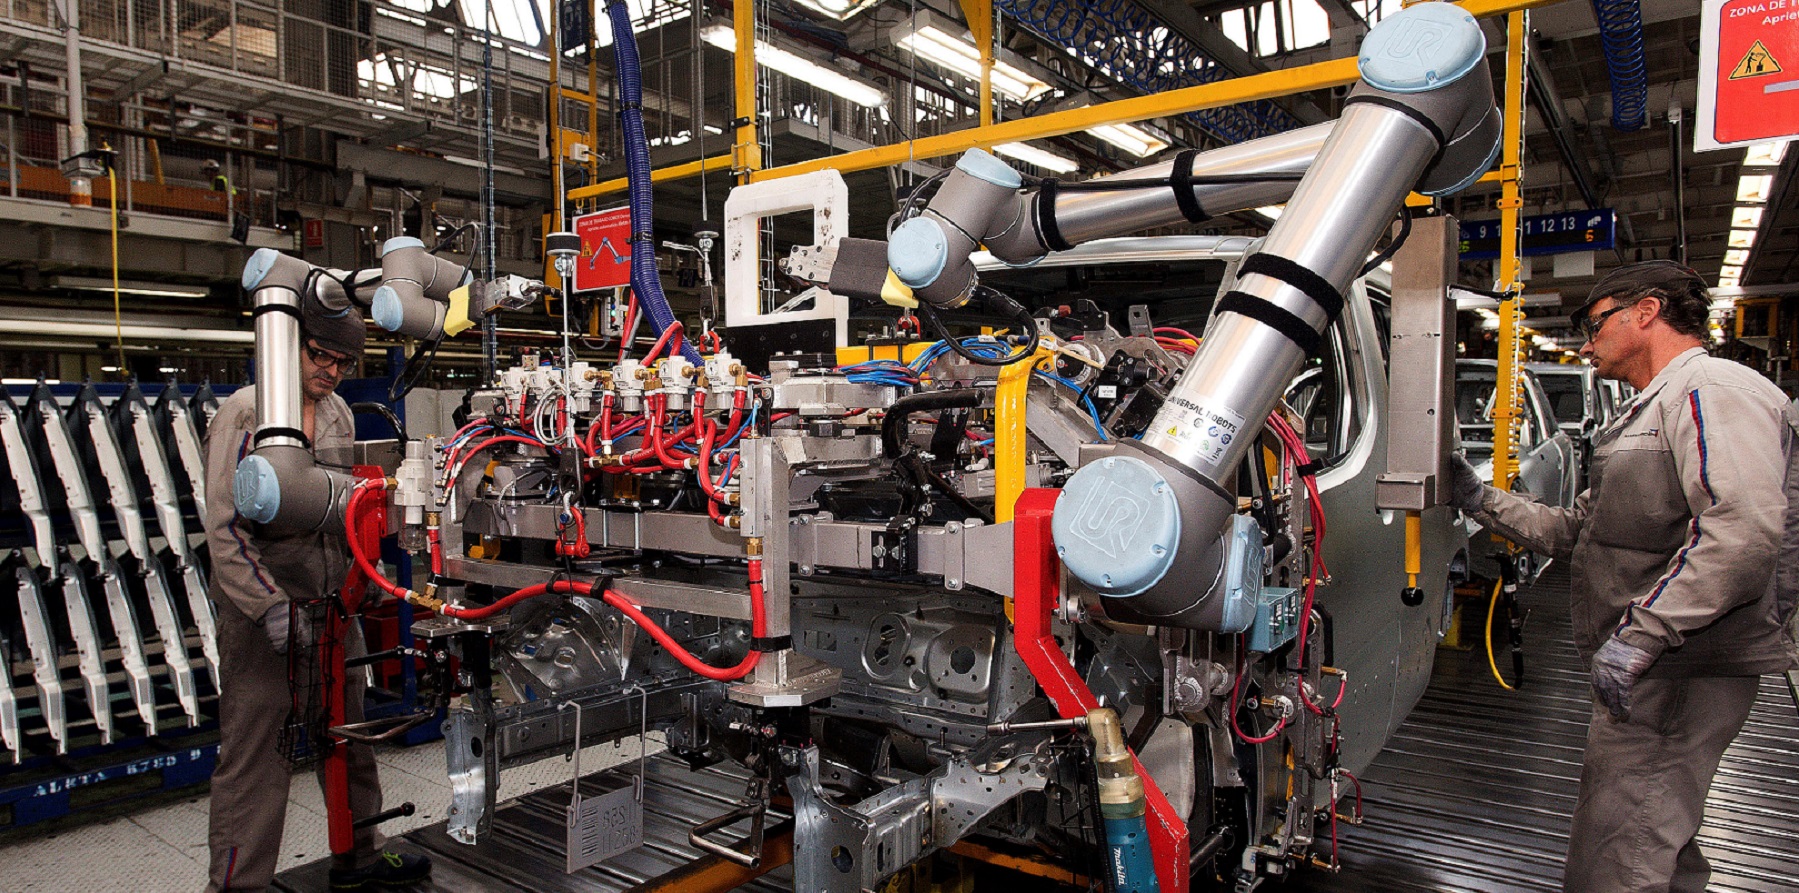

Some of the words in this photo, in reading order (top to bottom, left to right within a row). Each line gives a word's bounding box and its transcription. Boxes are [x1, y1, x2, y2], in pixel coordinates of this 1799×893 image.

[1729, 3, 1766, 18] ZONA
[1769, 0, 1786, 11] DE
[1479, 225, 1487, 239] 9
[1541, 219, 1555, 233] 12
[1561, 216, 1576, 231] 13
